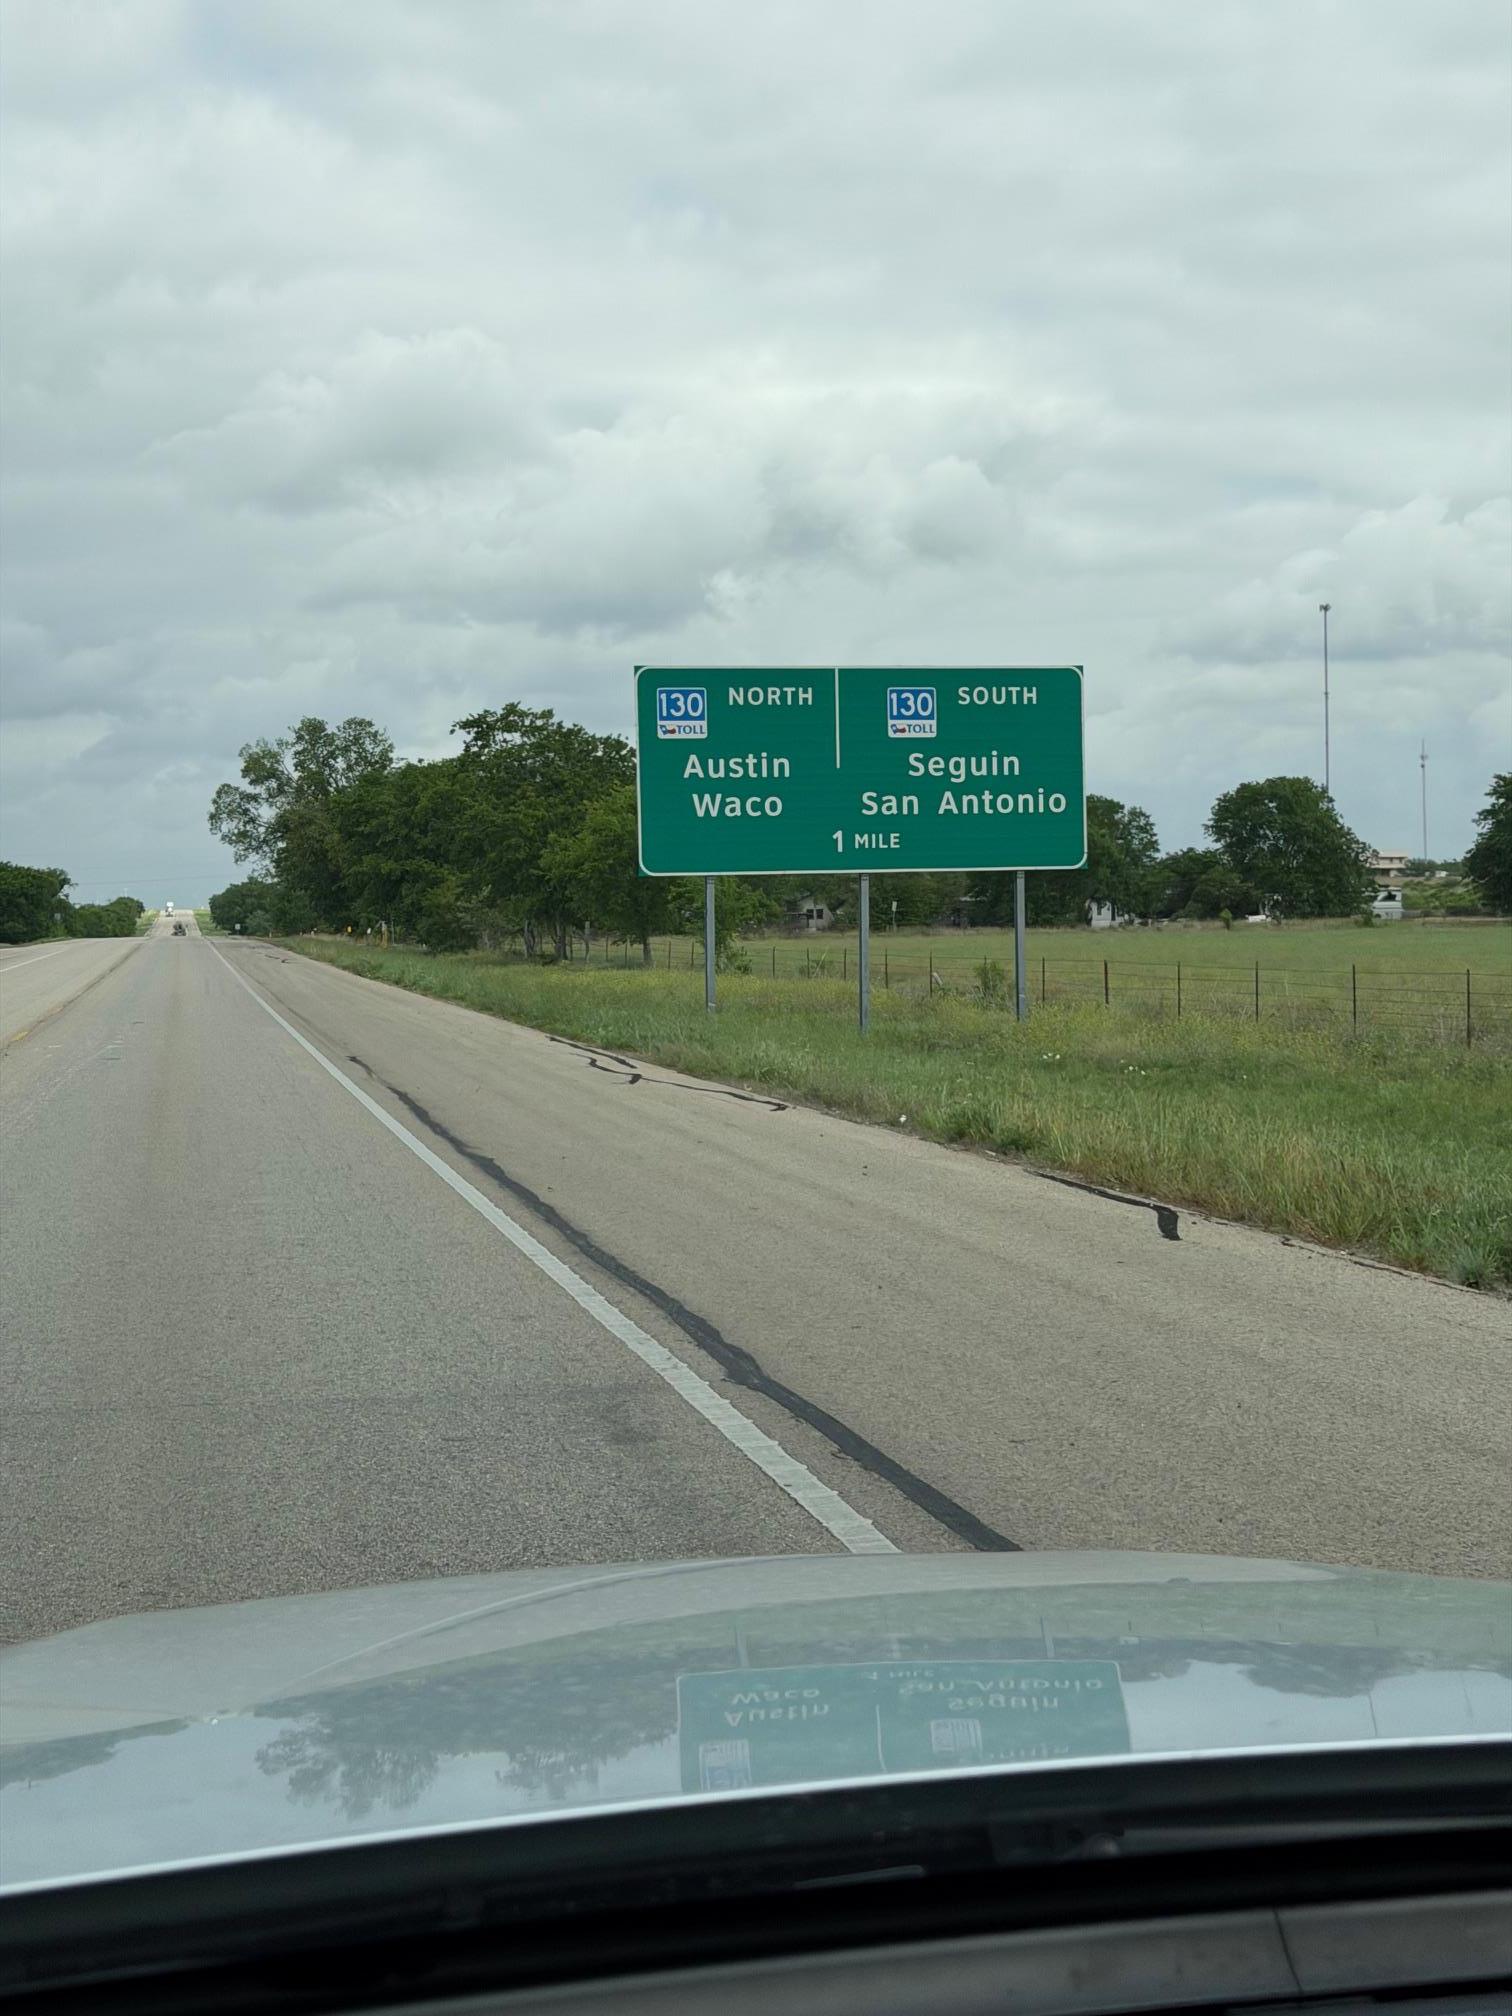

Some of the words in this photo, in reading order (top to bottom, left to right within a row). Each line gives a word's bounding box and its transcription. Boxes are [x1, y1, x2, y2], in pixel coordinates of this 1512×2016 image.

[660, 692, 704, 717] 130
[728, 687, 813, 706] NORTH
[890, 692, 933, 717] 130
[958, 686, 1037, 705] SOUTH
[676, 724, 706, 735] TOLL
[906, 723, 935, 734] TOLL
[683, 752, 790, 779] Austin
[909, 750, 1019, 783] Seguin
[692, 793, 783, 817] Waco
[862, 791, 919, 816] San
[938, 787, 1066, 815] Antonio
[832, 830, 843, 853] 1
[854, 833, 901, 849] MILE
